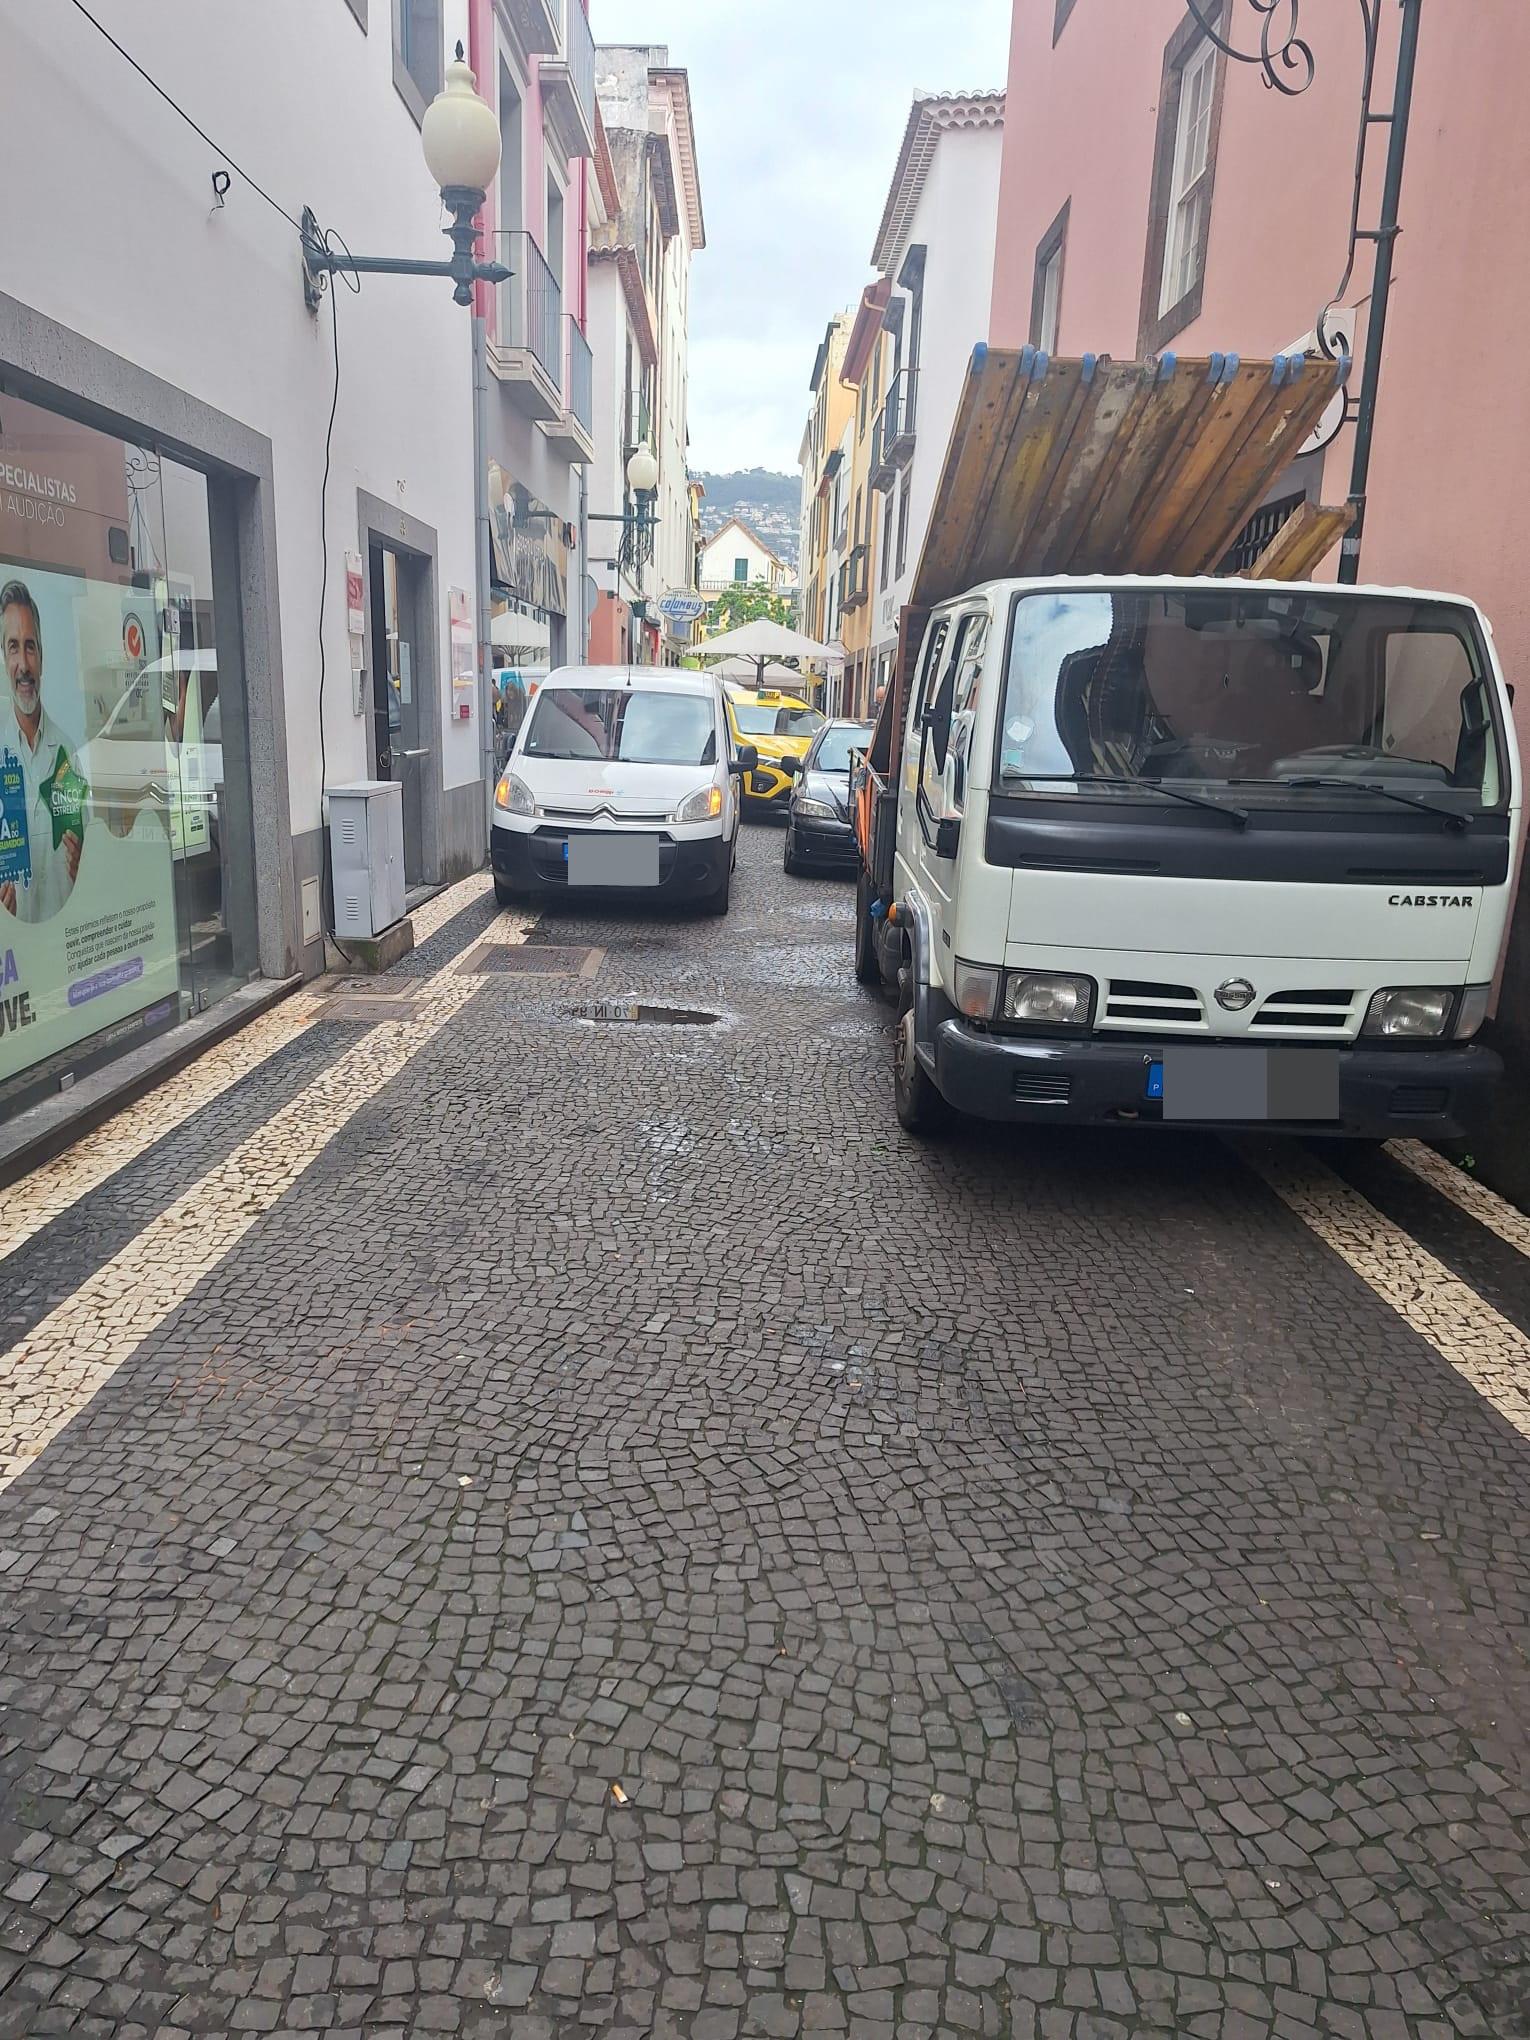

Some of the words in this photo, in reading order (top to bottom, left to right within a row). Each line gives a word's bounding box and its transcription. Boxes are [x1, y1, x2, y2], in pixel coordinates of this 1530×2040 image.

[8, 495, 65, 527] AUDIÇÃO
[52, 789, 79, 806] CINCO
[53, 804, 80, 817] ESTRELAS
[1388, 895, 1473, 907] CABSTAR
